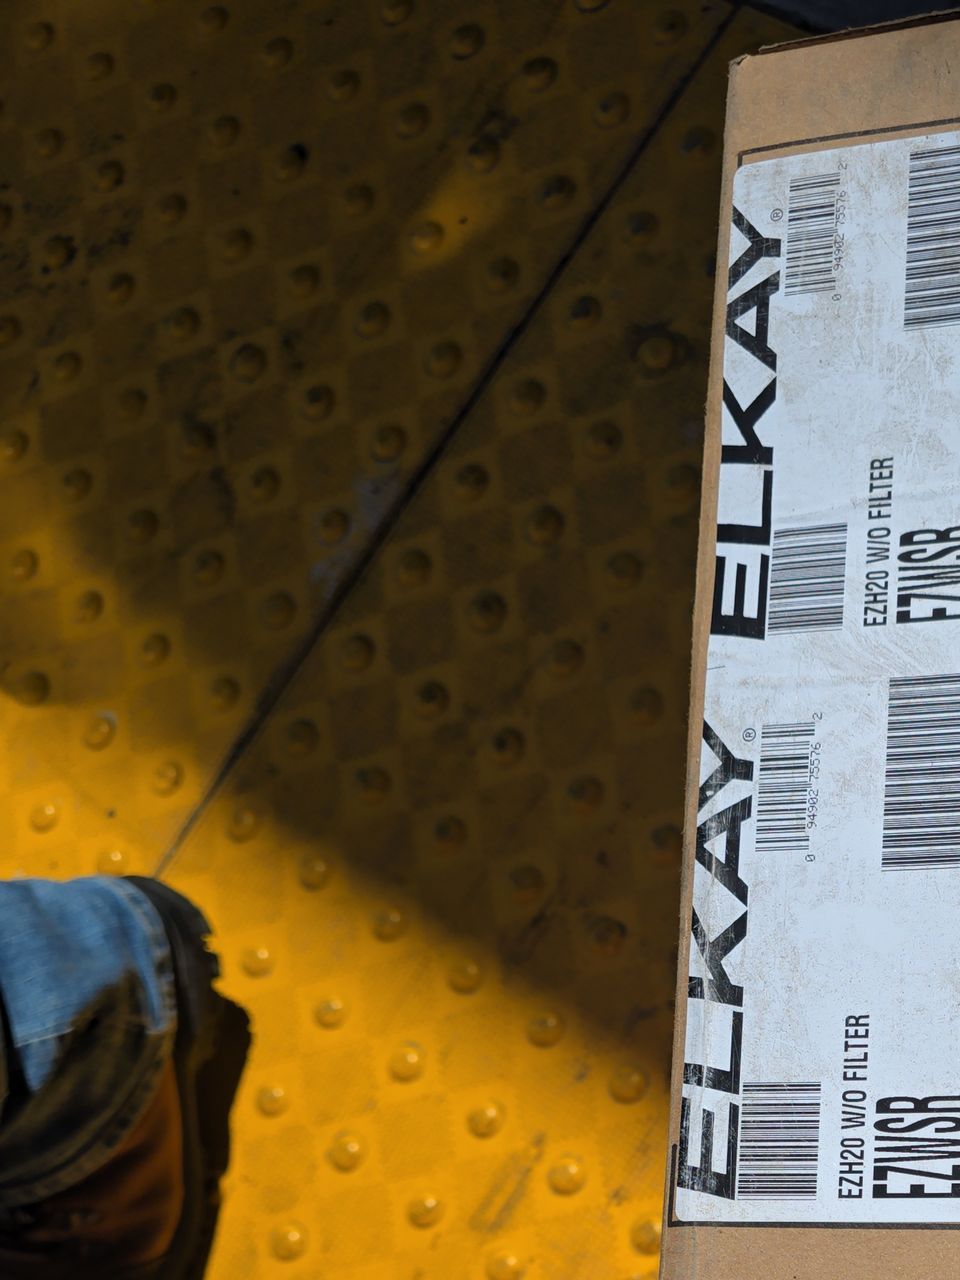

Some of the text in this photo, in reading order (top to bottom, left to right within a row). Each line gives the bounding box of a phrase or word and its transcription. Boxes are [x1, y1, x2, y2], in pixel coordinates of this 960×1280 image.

[838, 162, 847, 170] 2
[835, 190, 846, 225] 75576
[833, 233, 844, 271] 94902
[710, 204, 781, 640] ELKAY
[868, 457, 893, 519] FILTER
[866, 527, 890, 564] W/O
[809, 742, 821, 781] 75576
[807, 789, 818, 829] 94902
[677, 719, 754, 1200] ELKAY
[843, 1014, 869, 1080] FILTER
[841, 1090, 866, 1129] W/O
